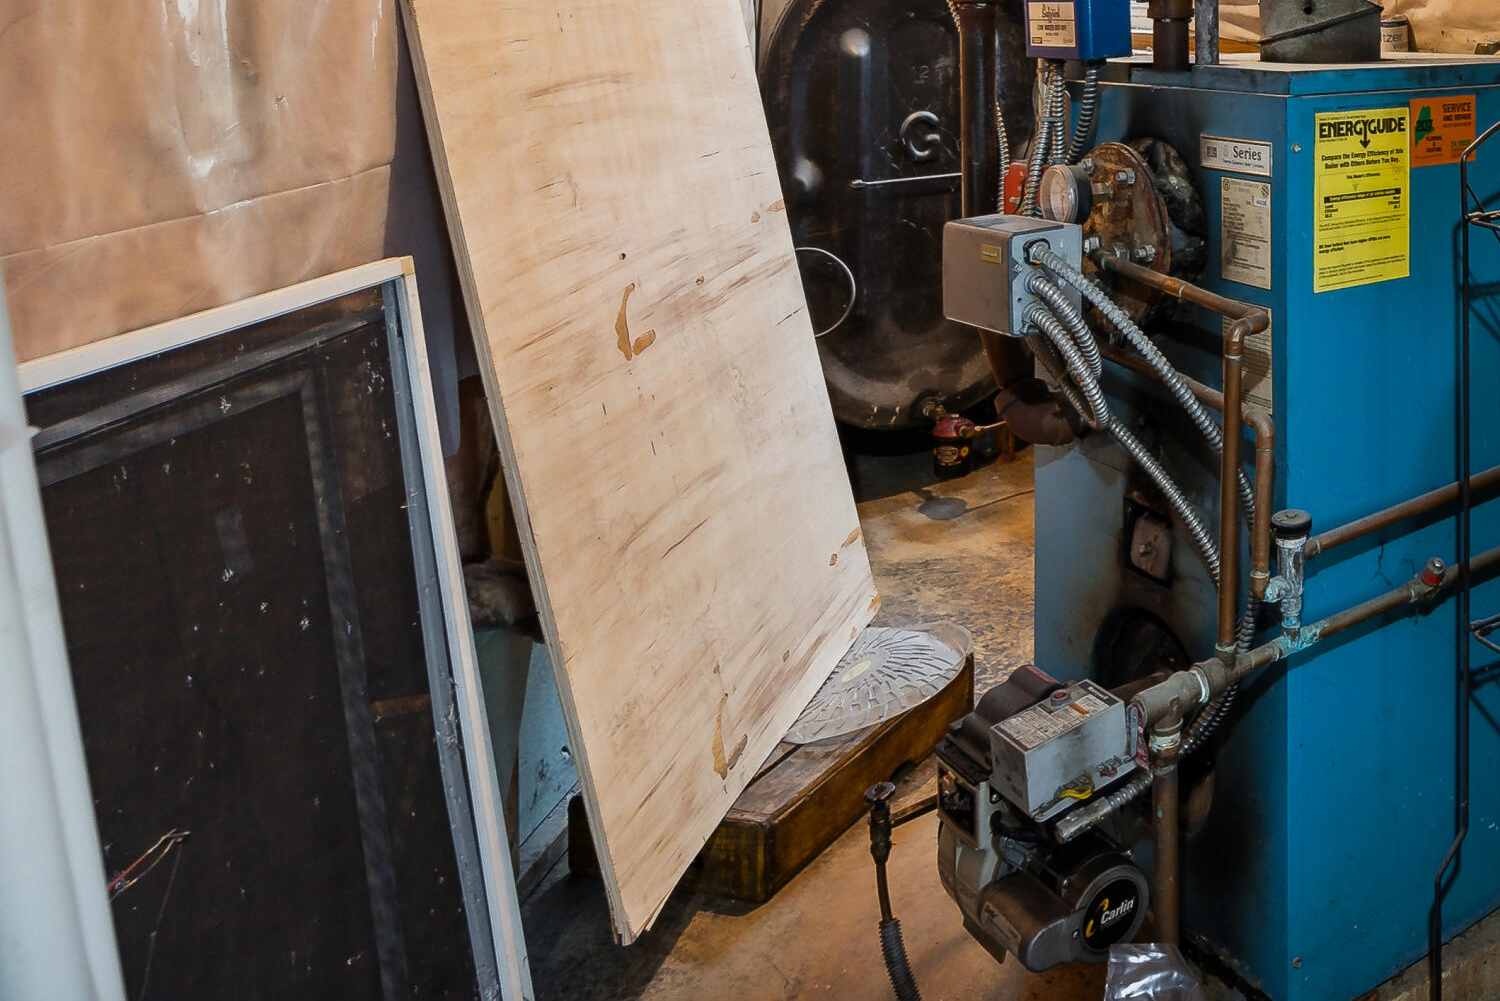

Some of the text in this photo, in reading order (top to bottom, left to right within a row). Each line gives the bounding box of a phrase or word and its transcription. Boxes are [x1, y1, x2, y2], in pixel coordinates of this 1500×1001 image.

[1443, 102, 1472, 113] SERVICE
[1319, 117, 1406, 139] ENERGYGUIDE
[1233, 146, 1262, 161] Series
[1101, 899, 1134, 924] Carlin
